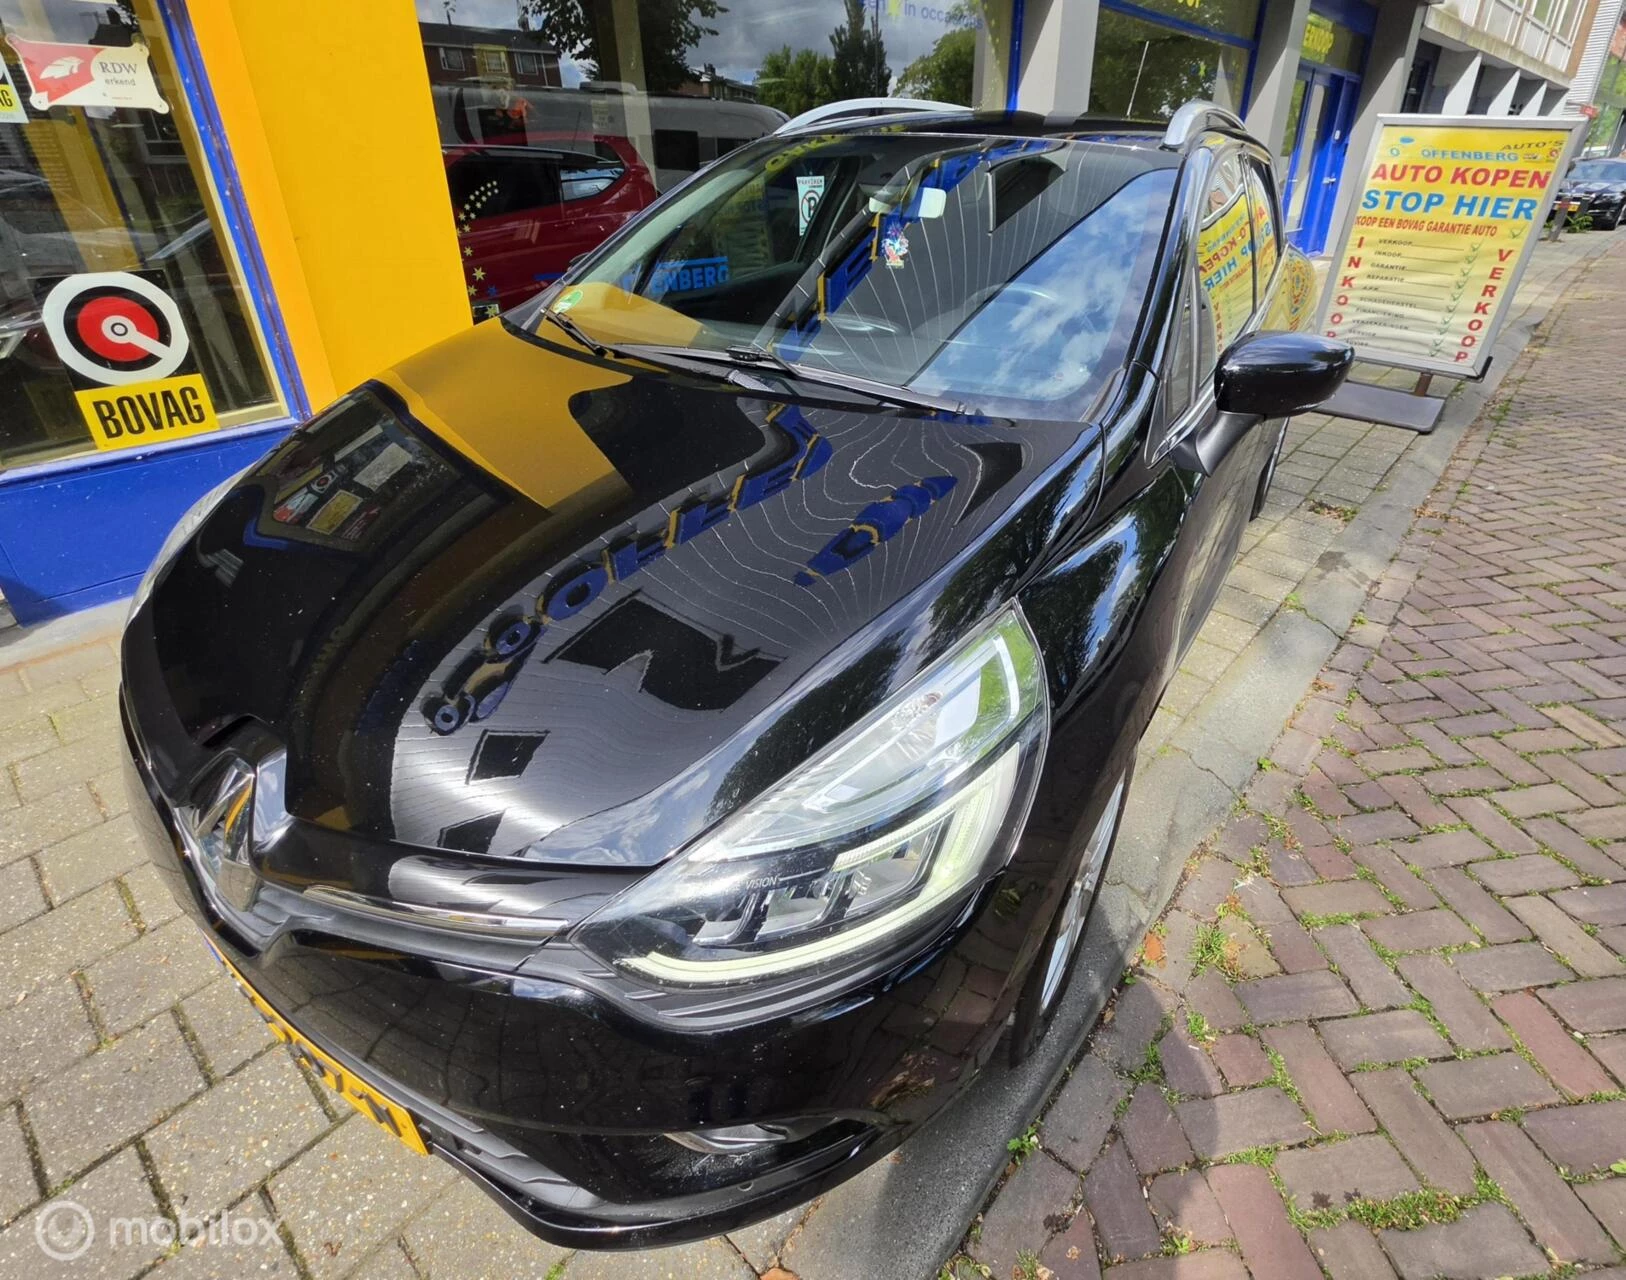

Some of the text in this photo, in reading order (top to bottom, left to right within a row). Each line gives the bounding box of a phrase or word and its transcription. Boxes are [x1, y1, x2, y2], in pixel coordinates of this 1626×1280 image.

[98, 61, 137, 74] RDW
[104, 77, 136, 86] erkend
[1501, 139, 1565, 151] AUTO'S
[1421, 149, 1519, 162] OFFENBERG
[1371, 163, 1553, 189] AUTO KOPEN
[1361, 188, 1539, 221] STOP HIER
[1355, 216, 1498, 238] KOOP EEN BOVAG GARANTIE AUTO
[1370, 262, 1407, 271] GARANTIE
[92, 386, 206, 439] BOVAG
[746, 874, 779, 891] VISION
